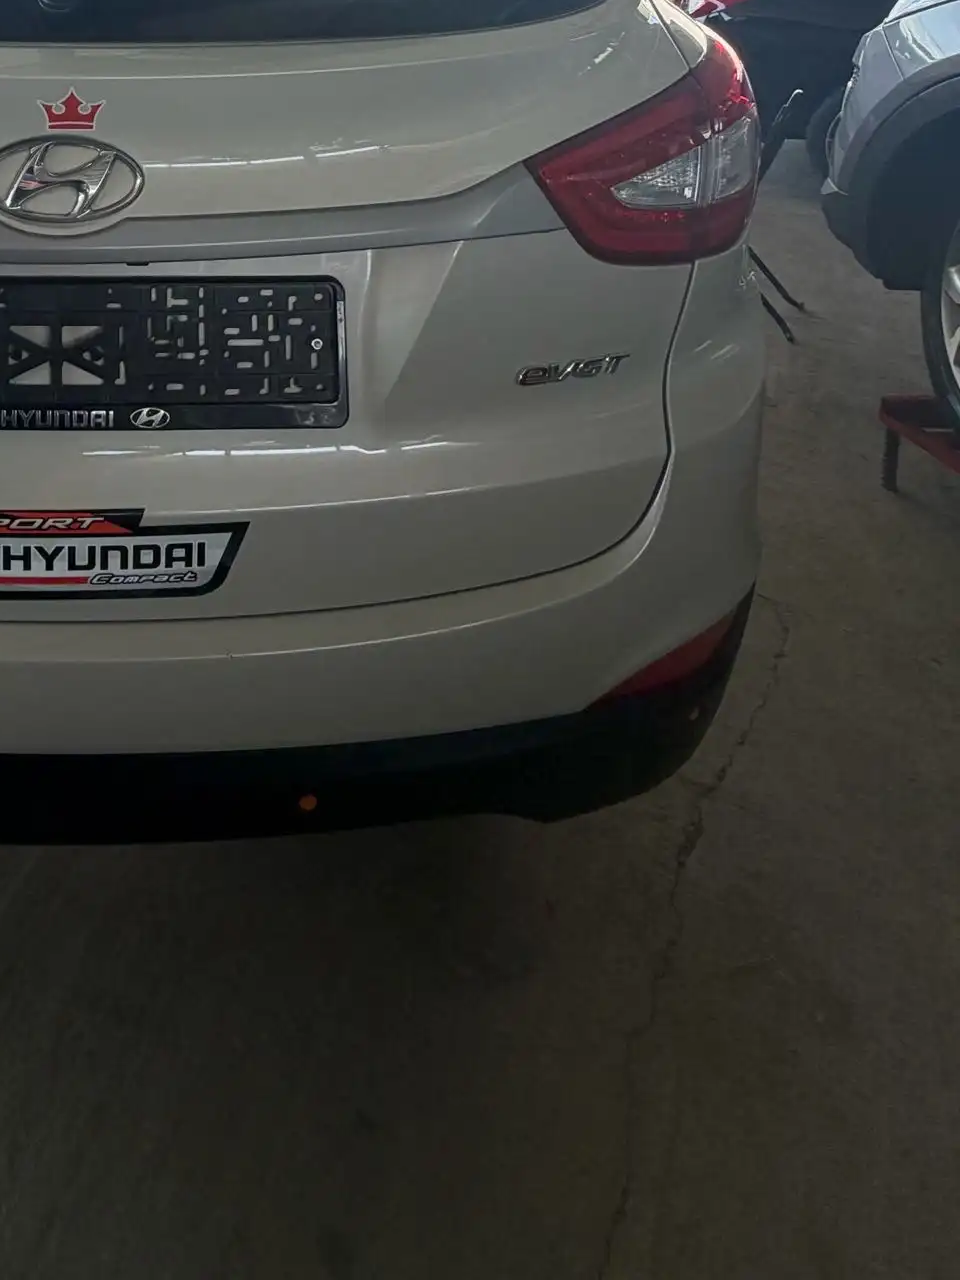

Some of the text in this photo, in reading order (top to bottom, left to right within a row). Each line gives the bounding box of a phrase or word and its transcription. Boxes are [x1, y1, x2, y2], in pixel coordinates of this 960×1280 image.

[0, 409, 115, 429] HYUNDAI
[1, 541, 207, 572] HYUNDAI
[87, 570, 199, 586] Compact
